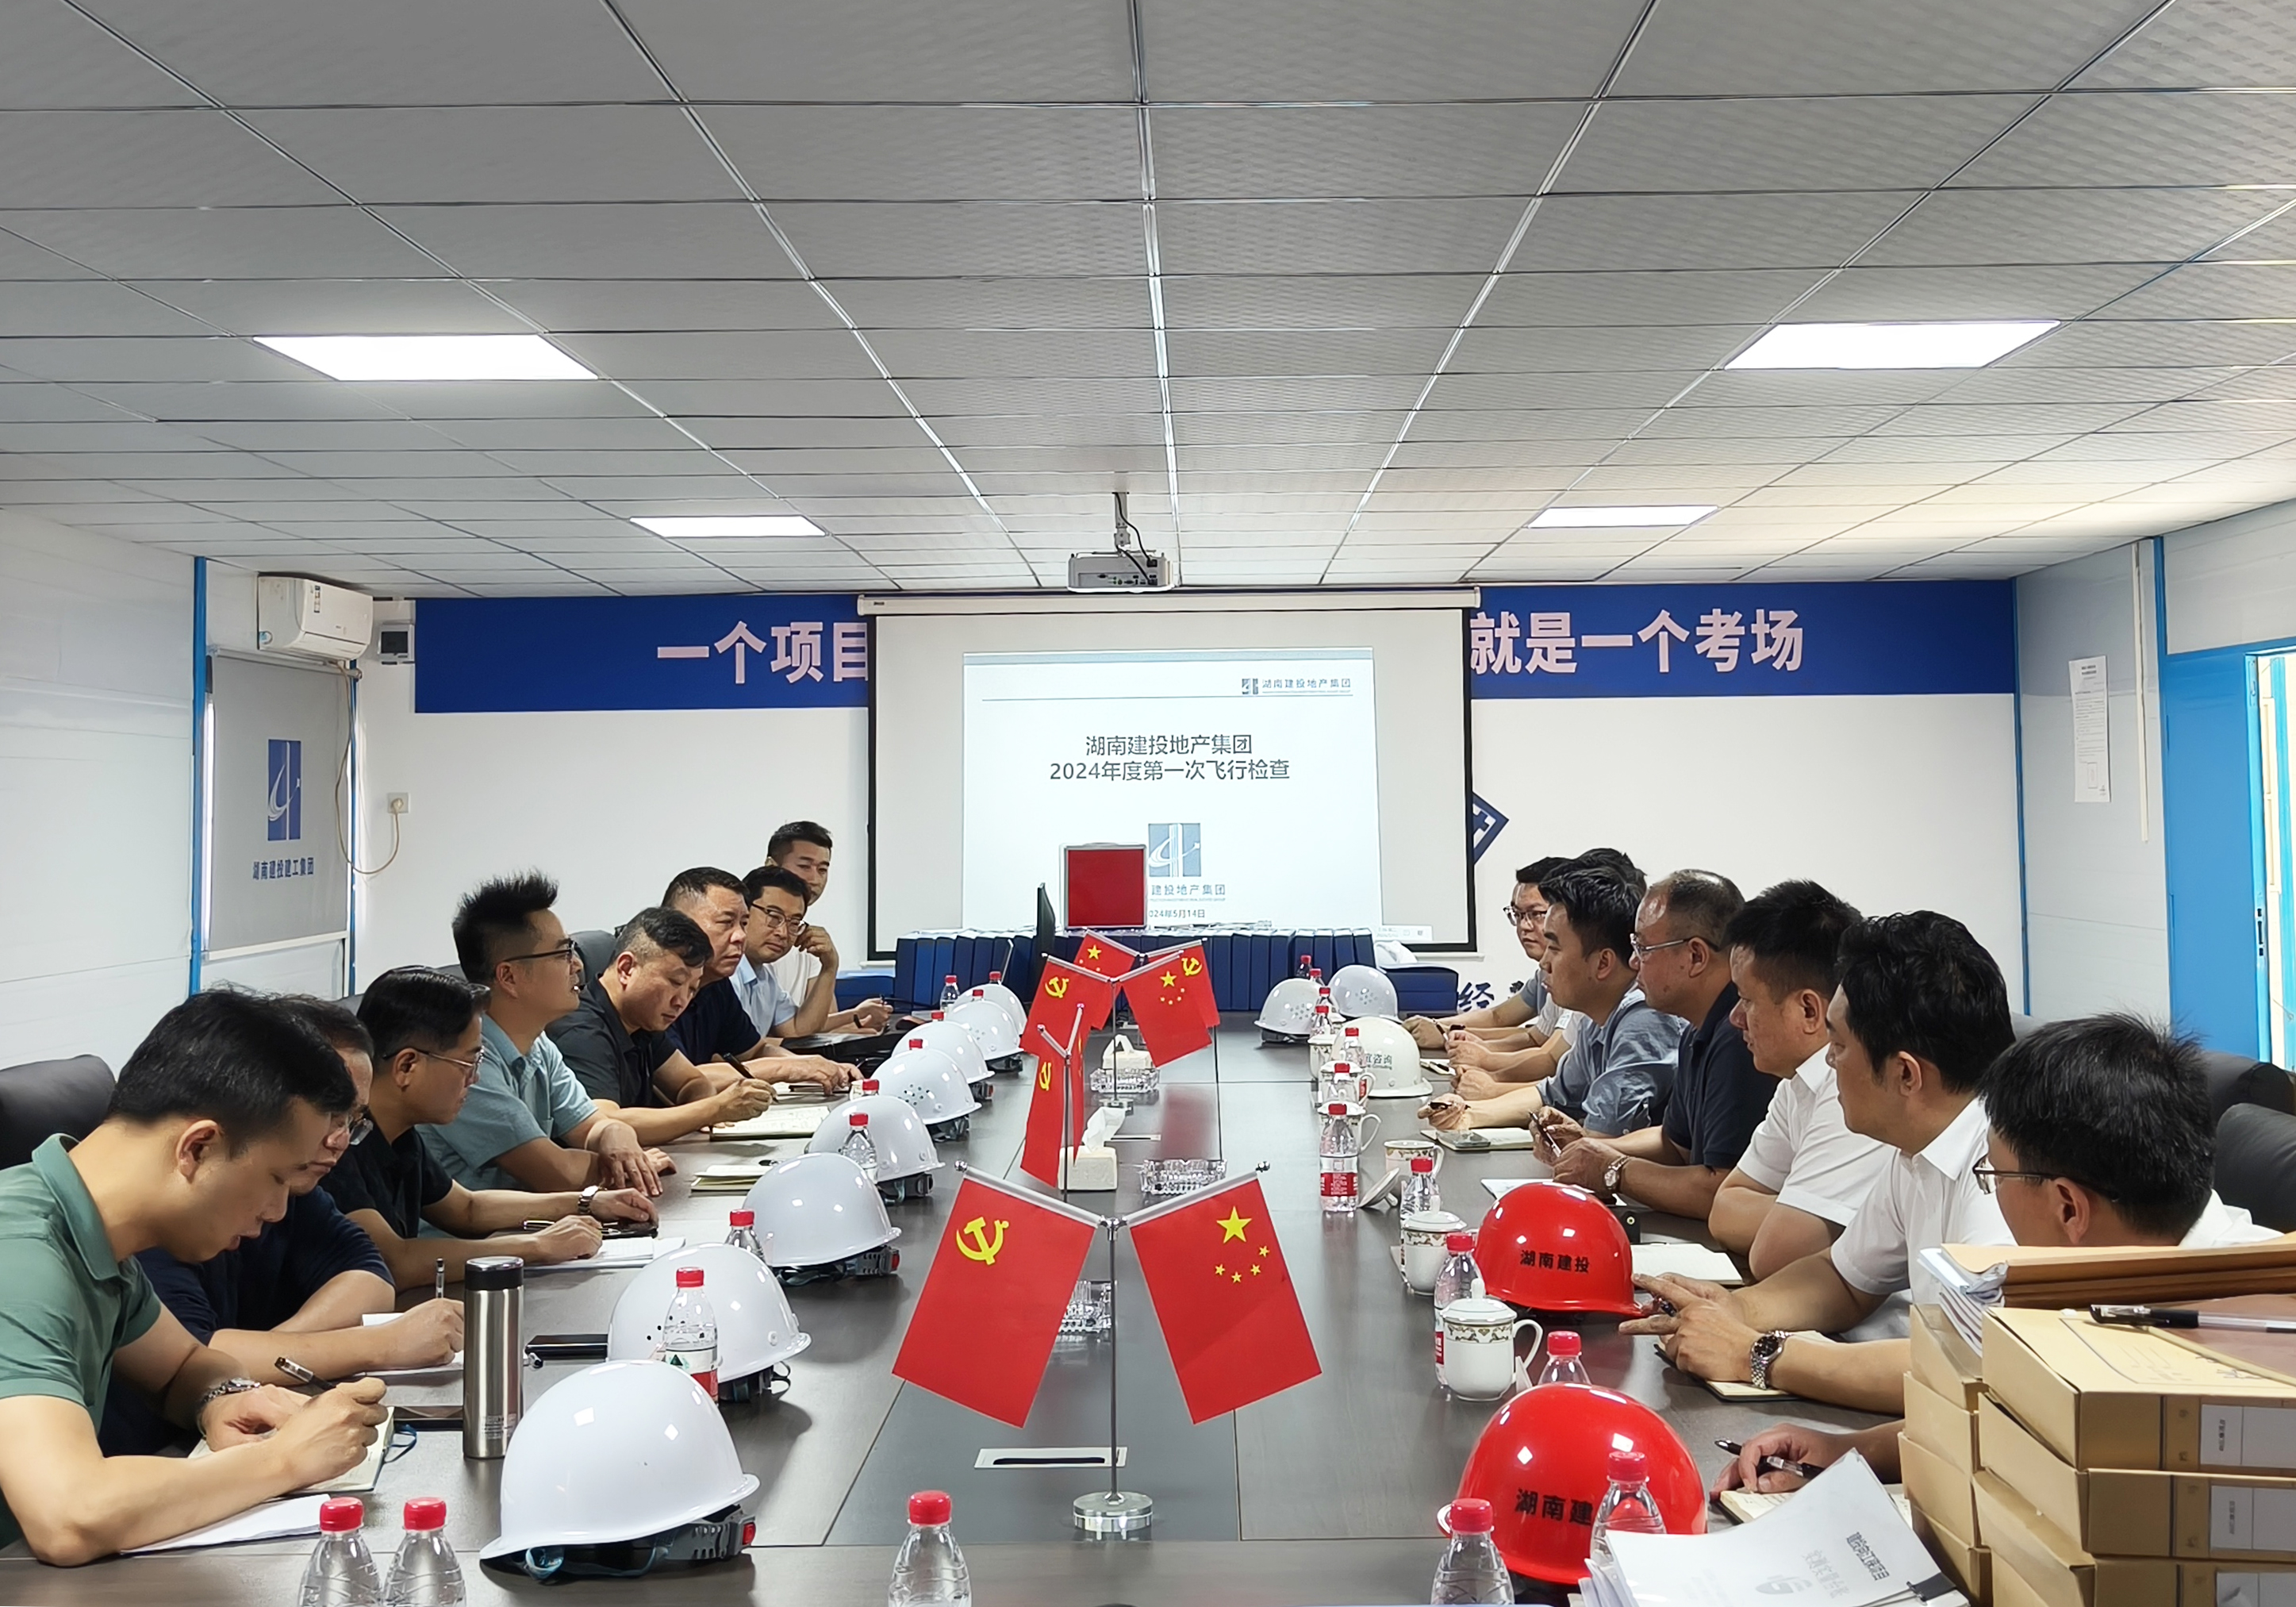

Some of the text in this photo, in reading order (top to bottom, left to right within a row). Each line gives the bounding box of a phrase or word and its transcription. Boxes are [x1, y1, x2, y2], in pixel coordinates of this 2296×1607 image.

[657, 621, 868, 684] 一个项目
[1469, 608, 1803, 675] 就是一个考场
[1262, 679, 1351, 688] 湖南建投地产集团
[1085, 735, 1253, 755] 湖南建投地产集团
[1050, 759, 1290, 781] 2024年度第一次飞行检查
[253, 857, 314, 880] 湖南建投建工集团
[1520, 1250, 1590, 1274] 湖南建投
[1515, 1487, 1593, 1526] 湖南建
